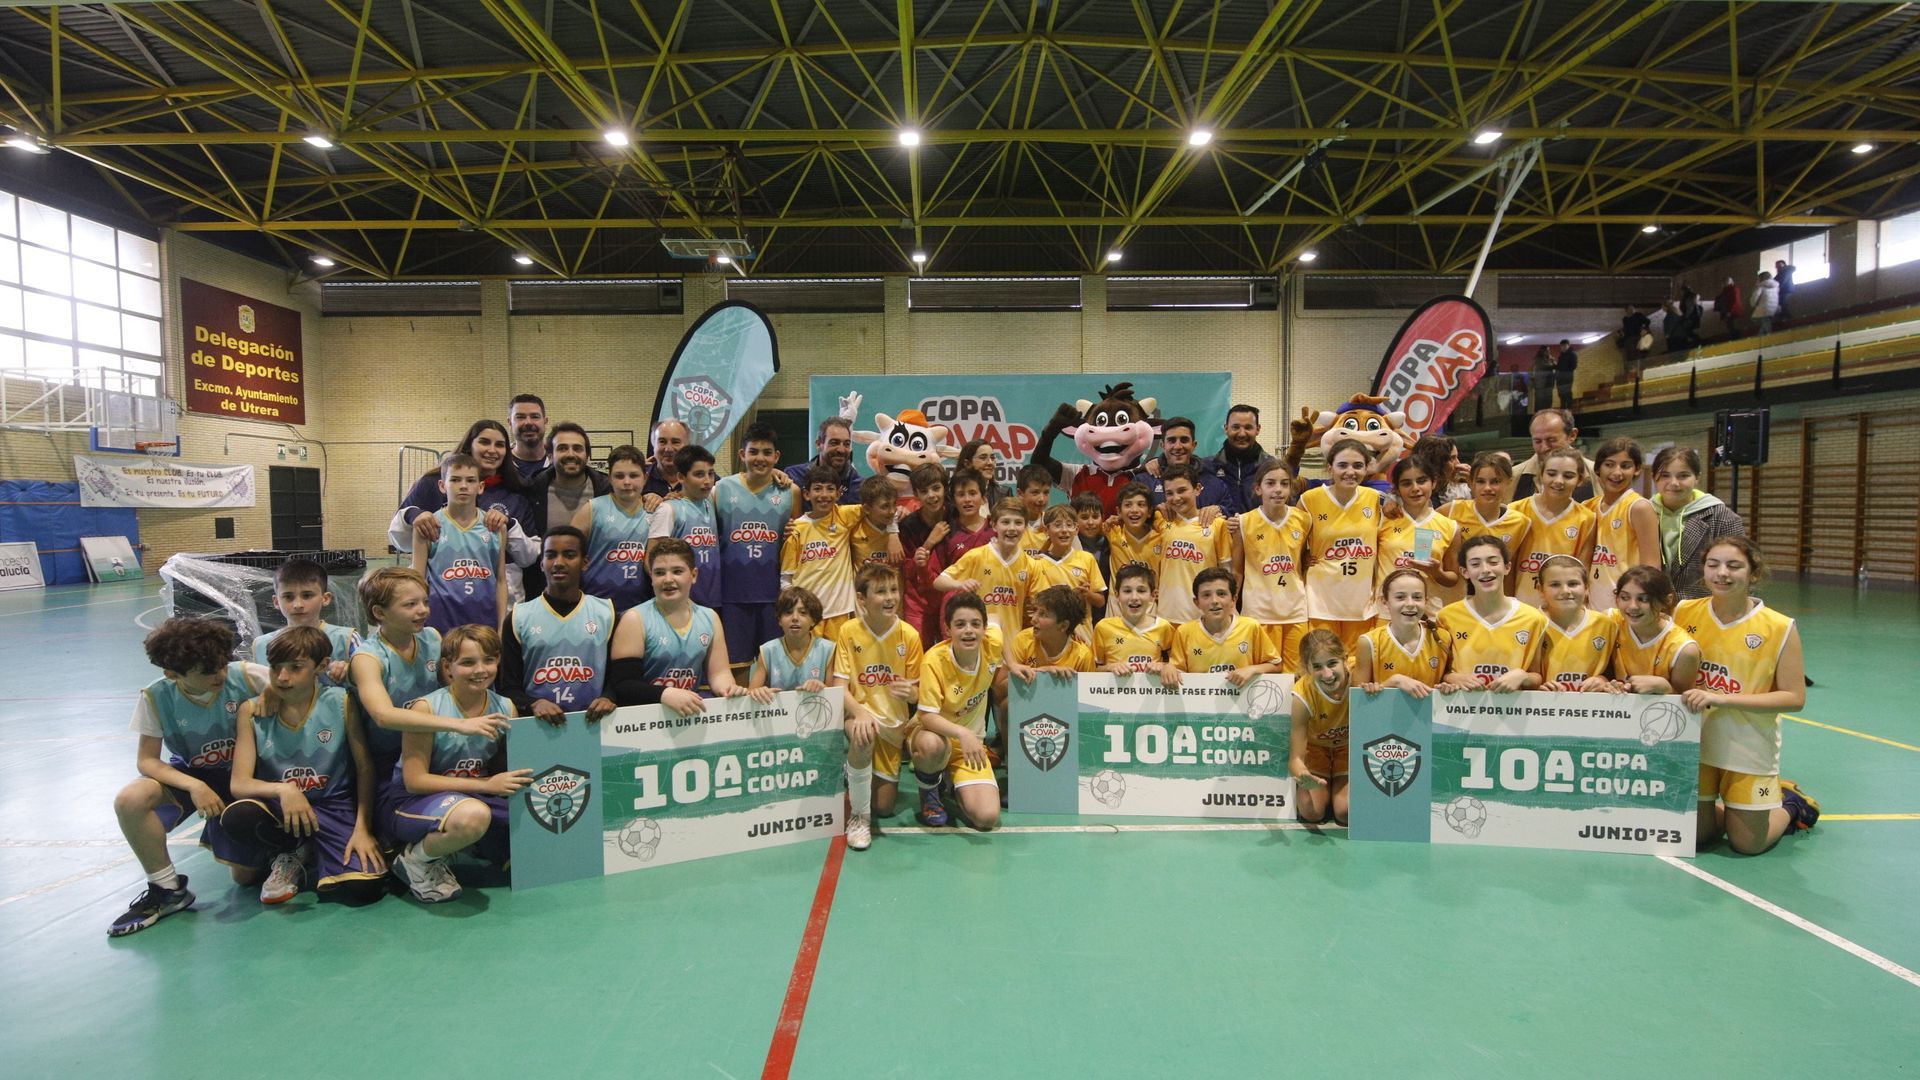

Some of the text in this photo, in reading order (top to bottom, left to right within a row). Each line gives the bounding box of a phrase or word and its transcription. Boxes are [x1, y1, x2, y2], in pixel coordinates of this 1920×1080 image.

[195, 325, 295, 361] Delegación
[191, 350, 300, 383] de Deportes
[1382, 343, 1440, 412] COPA
[194, 378, 299, 405] Excmo. Ayuntamiento
[693, 386, 714, 398] COPA
[1403, 332, 1481, 441] OVAP
[685, 390, 719, 407] COVAP
[221, 399, 279, 417] de Utrera
[921, 399, 1001, 421] COPA
[742, 522, 768, 530] COPA
[731, 530, 778, 541] COVAP
[619, 542, 643, 550] COPA
[806, 541, 828, 550] COPA
[1172, 540, 1195, 550] COPA
[1335, 538, 1362, 547] COPA
[607, 550, 645, 561] COVA
[698, 550, 709, 563] 11
[747, 545, 763, 558] 15
[871, 551, 888, 559] COP
[1166, 547, 1204, 562] COVAP
[1325, 546, 1373, 559] COVAP
[1271, 555, 1291, 563] COPA
[443, 567, 490, 579] COVAP
[622, 565, 637, 579] 12
[1341, 562, 1357, 575] 15
[1277, 575, 1287, 587] 4
[464, 581, 474, 595] 5
[993, 586, 1014, 594] COPA
[548, 657, 580, 667] COPA
[1128, 655, 1152, 663] COPA
[533, 667, 594, 683] COVAP
[666, 669, 693, 678] COPA
[865, 664, 892, 674] COPA
[1210, 664, 1236, 673] COPA
[1474, 665, 1509, 674] COPA
[1699, 661, 1728, 676] OPA
[552, 687, 575, 704] 14
[1089, 687, 1115, 695] VALE
[1117, 687, 1137, 695] POR
[1139, 687, 1153, 695] UN
[1182, 688, 1206, 696] FASE
[1208, 688, 1240, 696] FINAL
[1446, 706, 1631, 719] VALE POR UN PASE FASE FINAL
[616, 708, 789, 734] VALE POR UN PASE FASE FINAL
[1030, 728, 1059, 736] COVAP
[1202, 726, 1255, 742] COPA
[747, 747, 804, 768] COPA
[1202, 749, 1270, 765] COVAP
[1375, 750, 1409, 758] COVAP
[1581, 751, 1648, 771] COPA
[285, 768, 315, 779] COPA
[546, 776, 570, 784] COPA
[539, 780, 577, 793] COVAP
[747, 769, 819, 793] COVAP
[1580, 777, 1666, 797] COVAP
